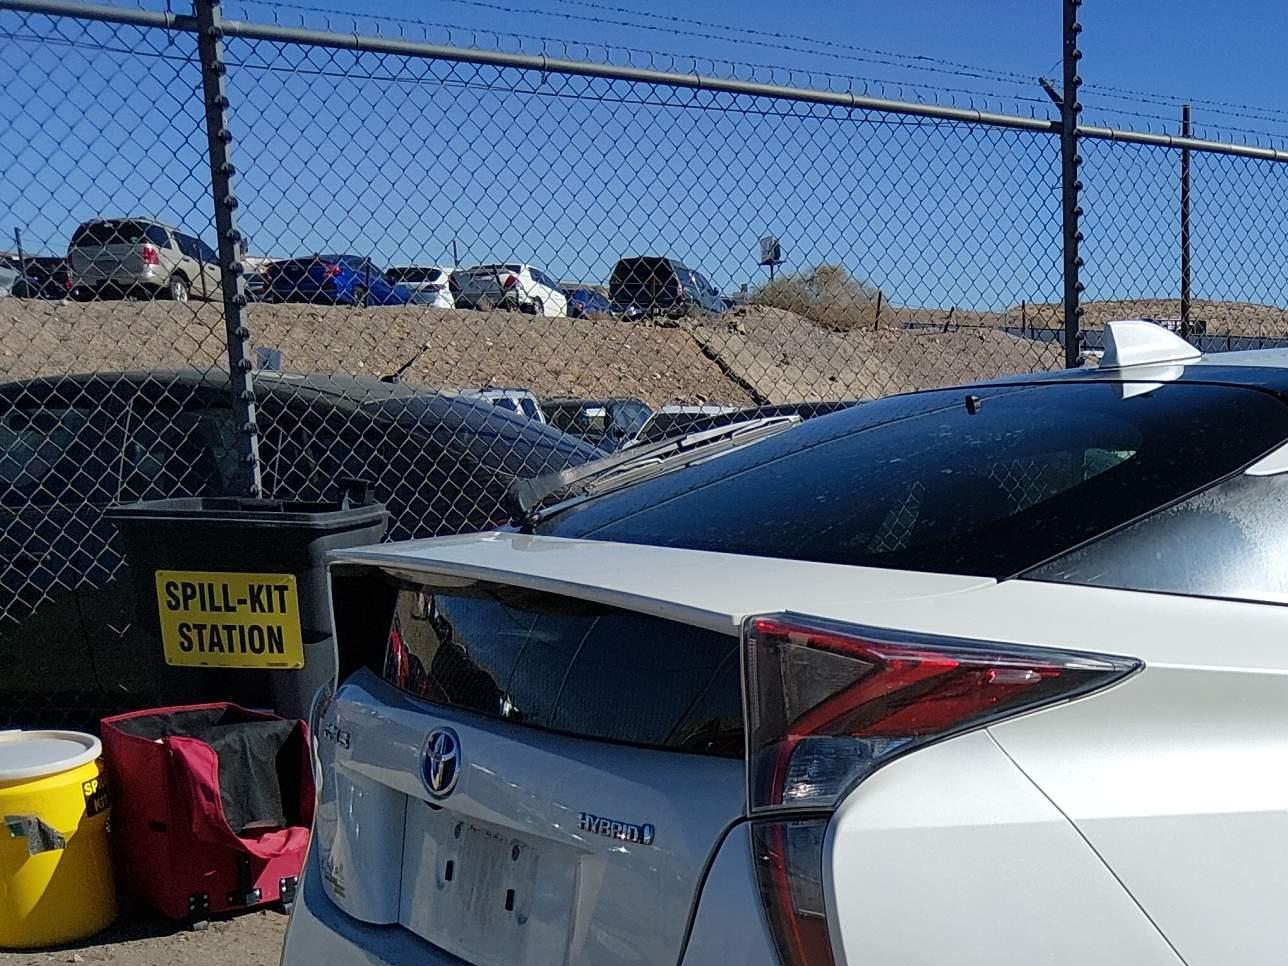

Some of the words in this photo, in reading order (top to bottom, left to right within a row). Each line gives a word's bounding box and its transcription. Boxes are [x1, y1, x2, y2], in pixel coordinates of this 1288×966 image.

[165, 581, 288, 613] SPILL-KIT
[178, 622, 285, 654] STATION
[577, 812, 640, 843] HYBRID
